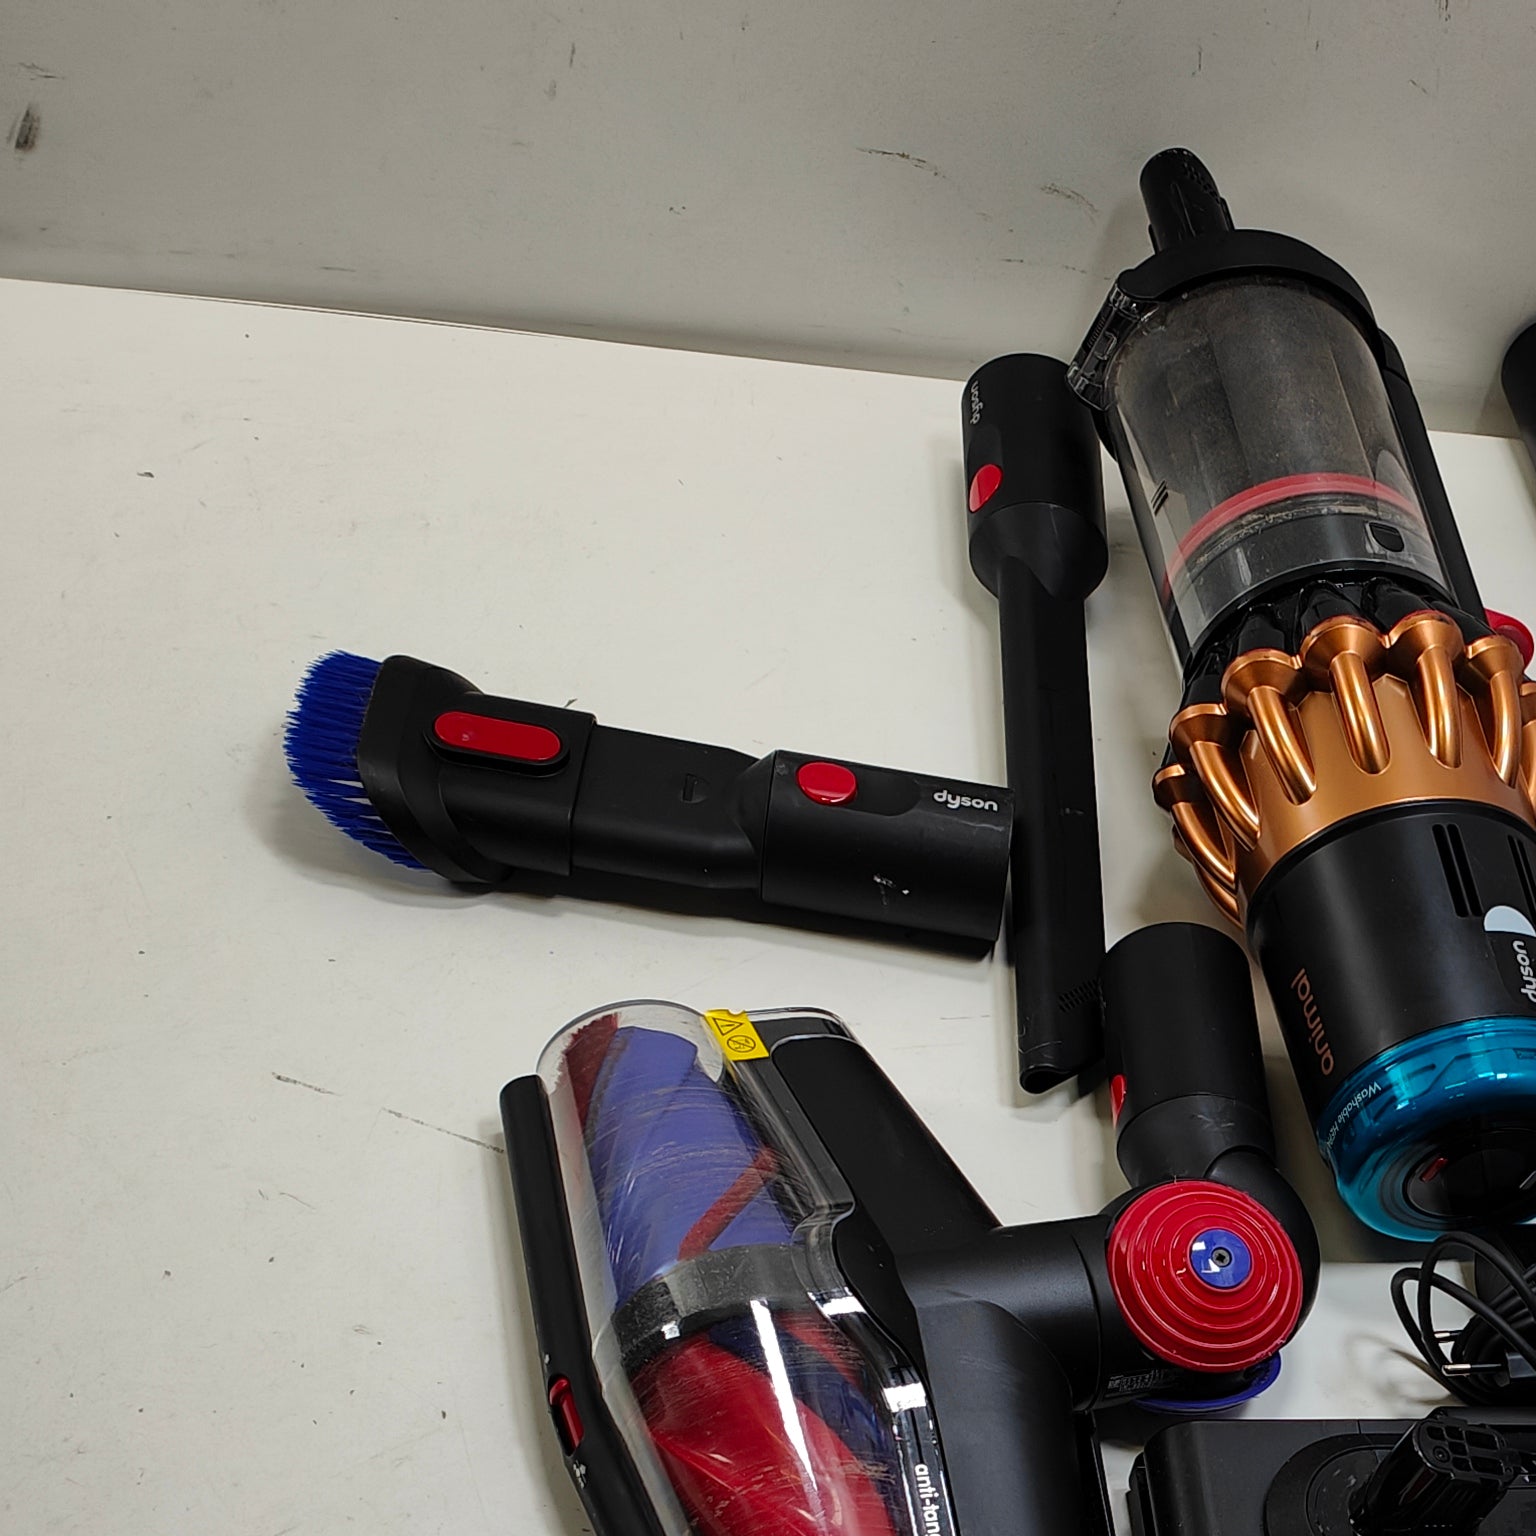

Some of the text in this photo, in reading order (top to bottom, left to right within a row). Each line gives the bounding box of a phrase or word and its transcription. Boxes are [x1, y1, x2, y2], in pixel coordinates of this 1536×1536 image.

[969, 380, 984, 425] dyson
[933, 789, 998, 812] dyson
[1290, 967, 1335, 1076] animal
[1337, 1081, 1382, 1125] Washable
